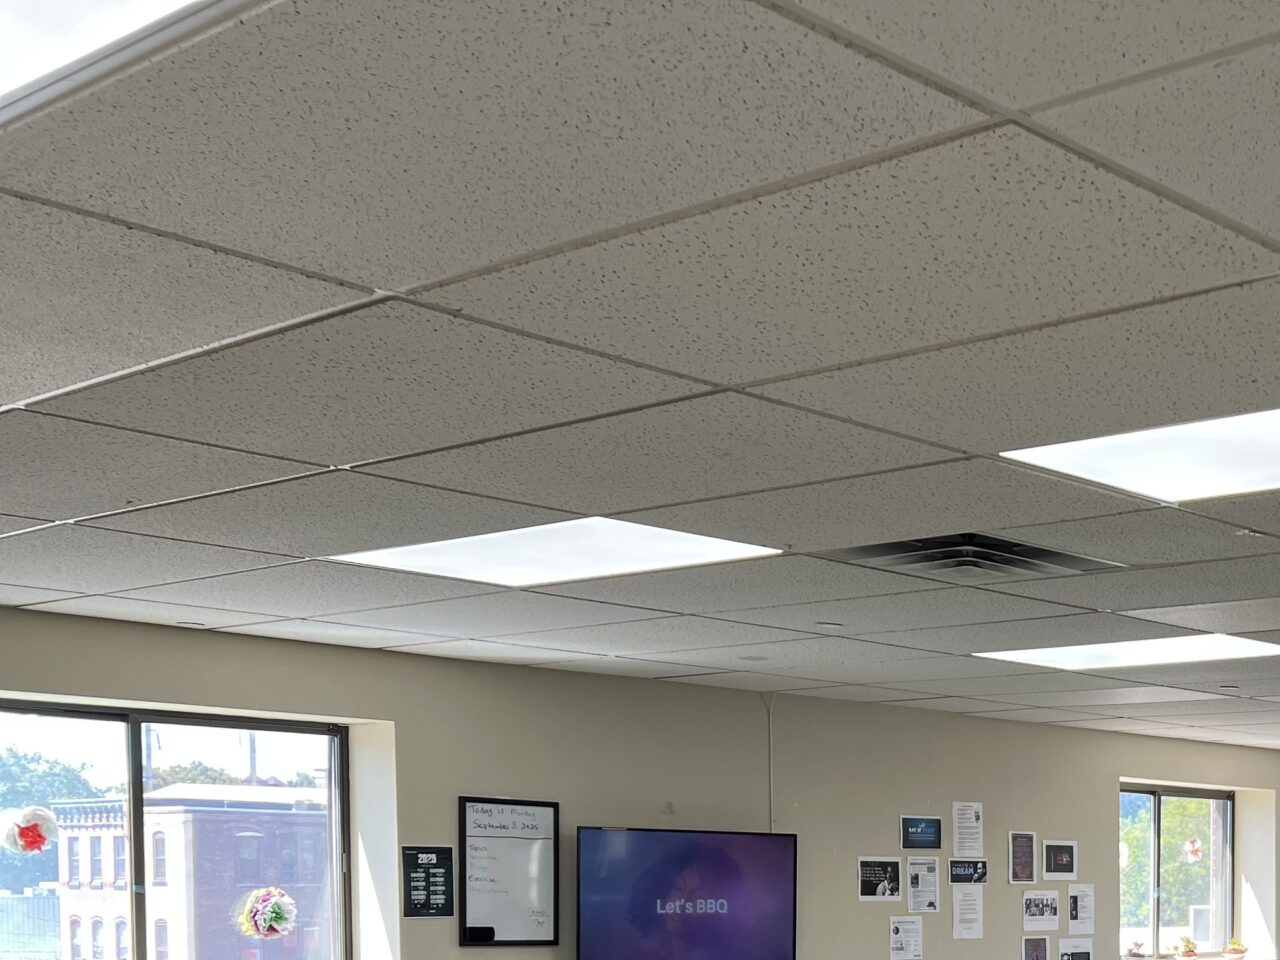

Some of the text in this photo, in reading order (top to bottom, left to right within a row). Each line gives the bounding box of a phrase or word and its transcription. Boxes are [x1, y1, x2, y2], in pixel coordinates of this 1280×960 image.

[468, 804, 536, 821] Today is Monday
[472, 819, 509, 831] September
[951, 867, 974, 875] DREAM
[656, 898, 728, 914] Let's BBQ
